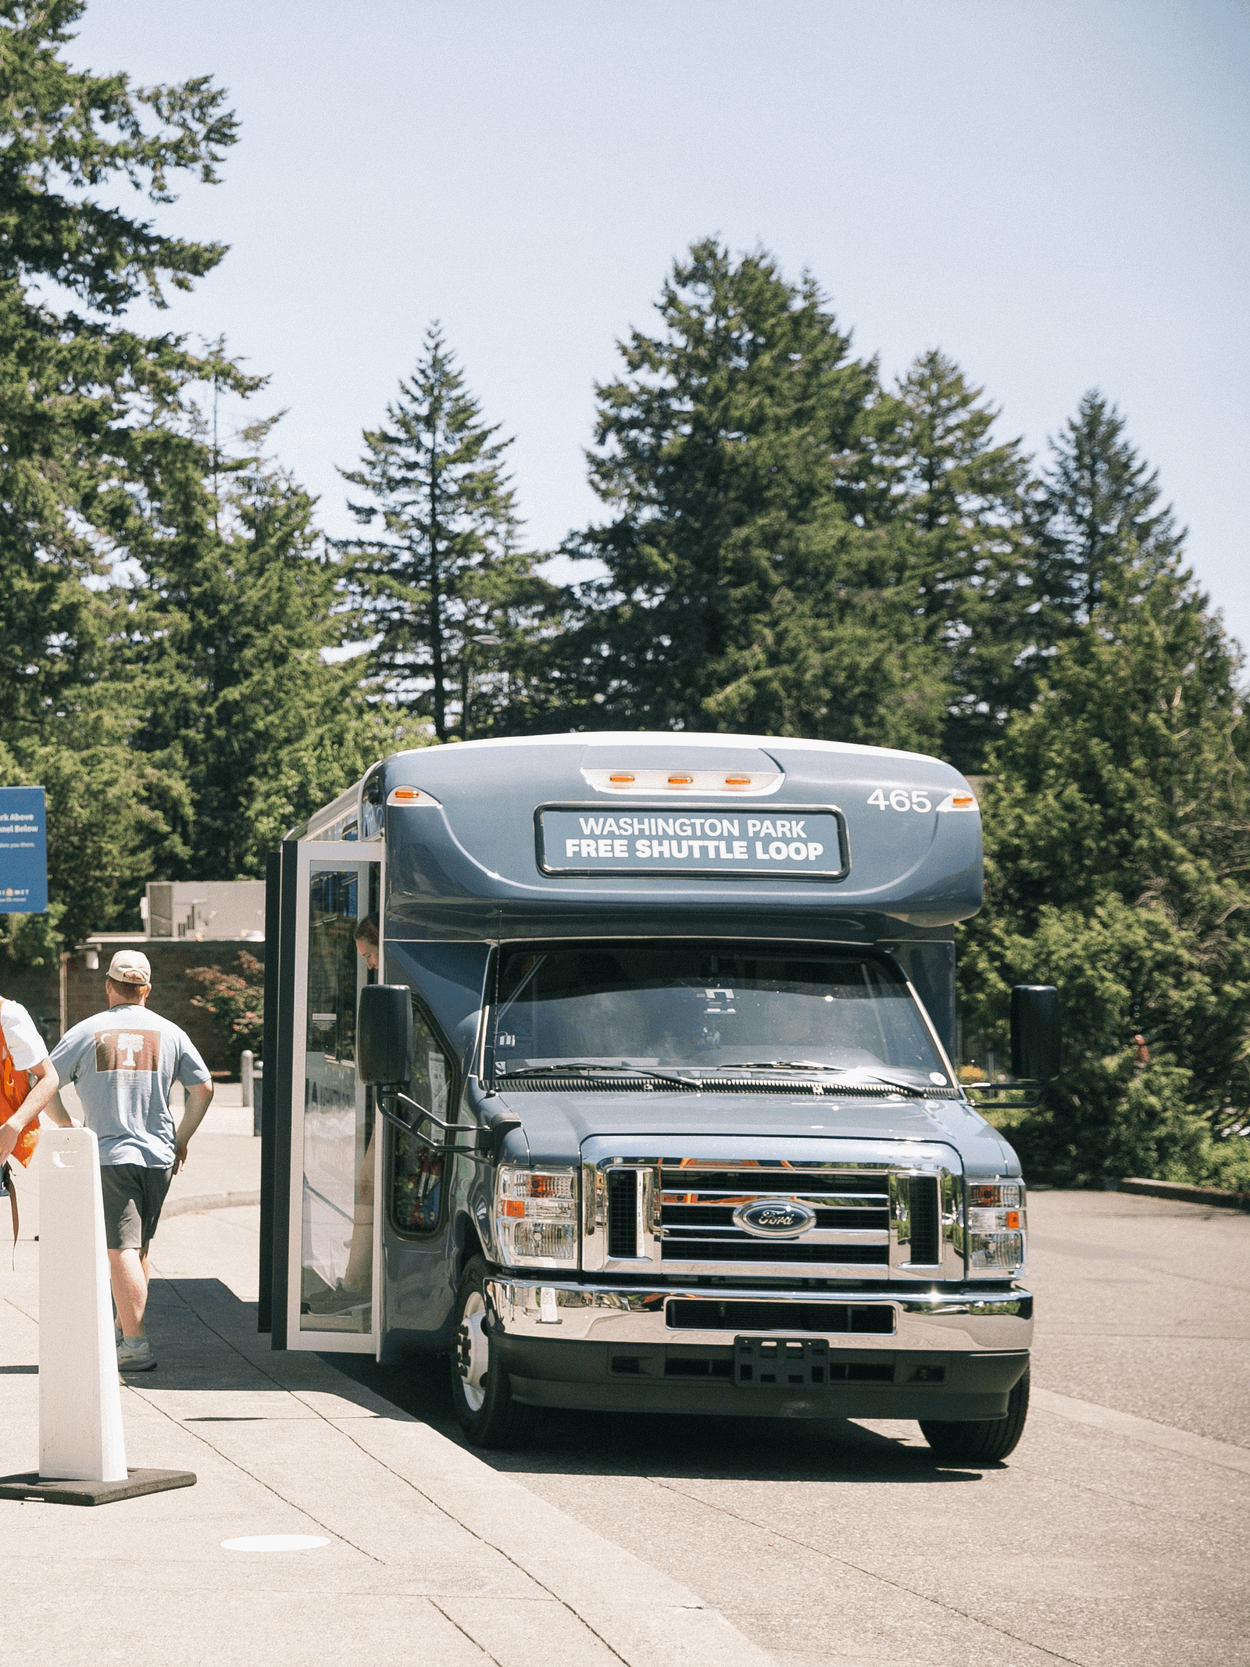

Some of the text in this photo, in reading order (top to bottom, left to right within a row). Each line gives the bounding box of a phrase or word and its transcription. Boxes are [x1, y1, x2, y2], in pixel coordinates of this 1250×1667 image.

[866, 788, 932, 814] 465
[579, 817, 807, 838] WASHINGTON PARK
[565, 838, 824, 861] FREE SHUTTLE LOOP
[758, 1209, 795, 1225] Ford
